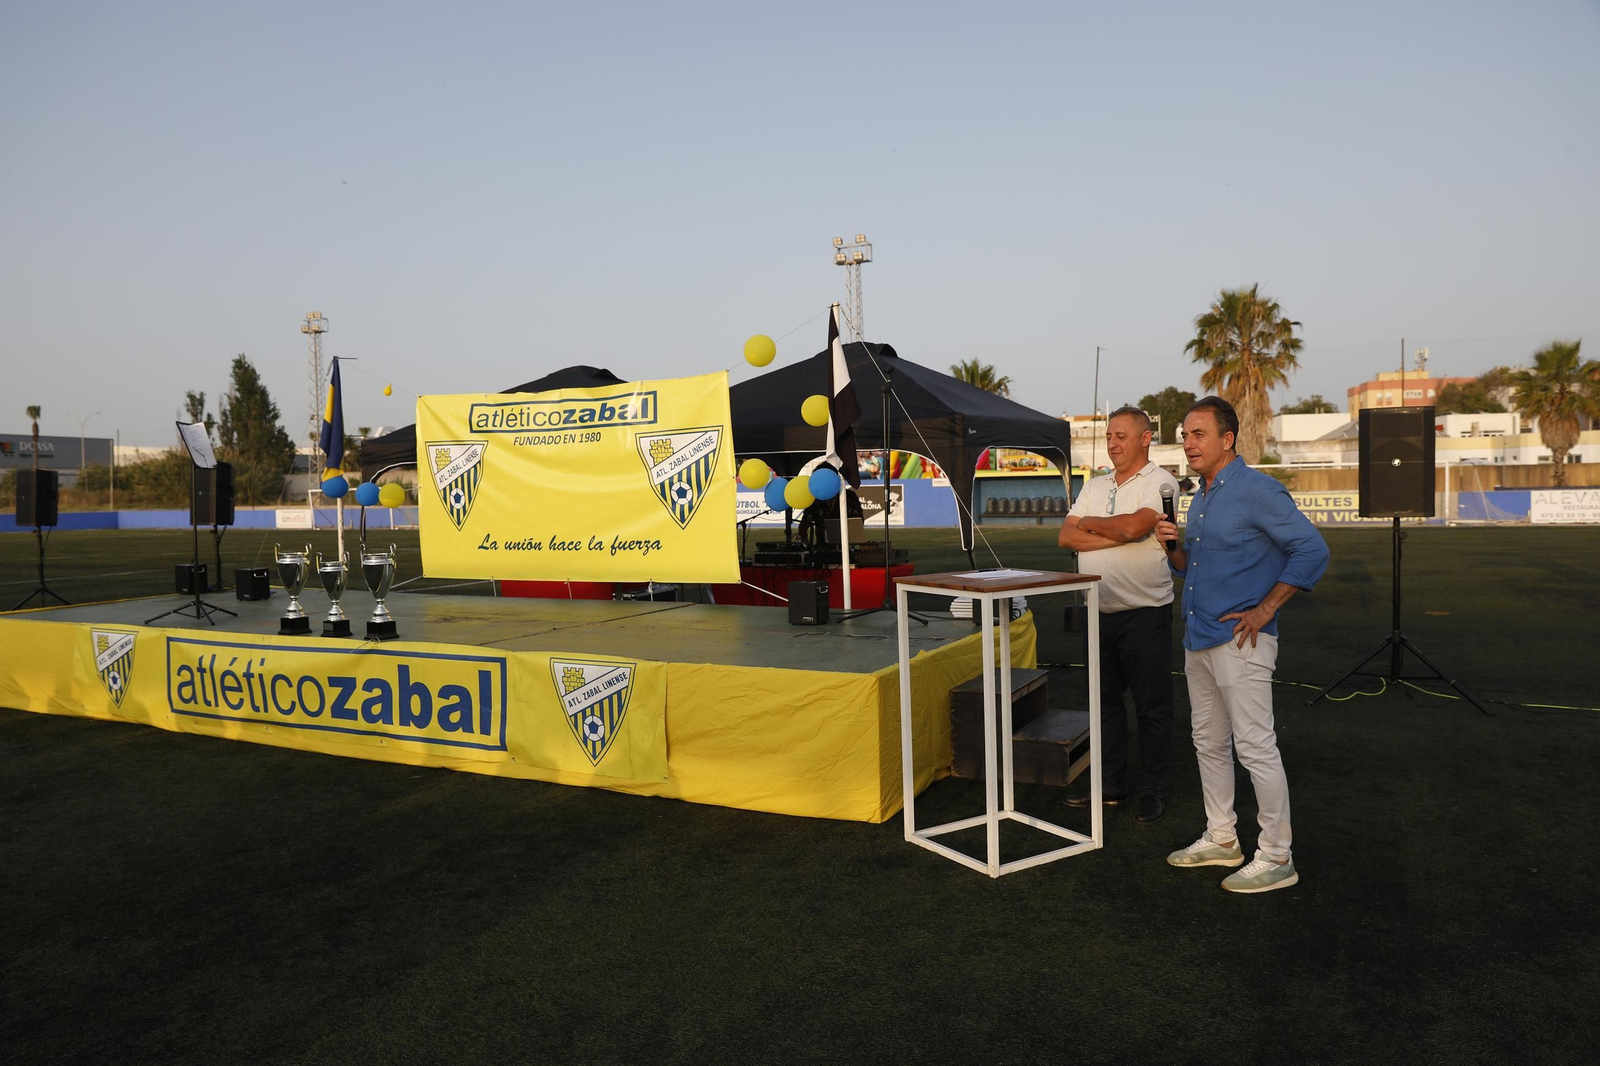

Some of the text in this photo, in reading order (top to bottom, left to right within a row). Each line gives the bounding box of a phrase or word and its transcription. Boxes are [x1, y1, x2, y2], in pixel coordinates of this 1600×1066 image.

[476, 398, 648, 428] atléticozabal
[513, 432, 601, 446] FUNDADO EN 1980
[447, 463, 462, 477] ZABAL
[462, 448, 479, 466] LINENSE
[656, 435, 715, 479] ATL. ZABAL LINENSE
[736, 499, 760, 508] ÚTBOL
[1294, 497, 1353, 507] SULTES
[1535, 491, 1600, 504] ALEVA
[478, 533, 662, 556] La unión hace la fuerza
[177, 653, 492, 736] atléticozabal
[567, 671, 628, 708] ATL. ZABAL LINENSE
